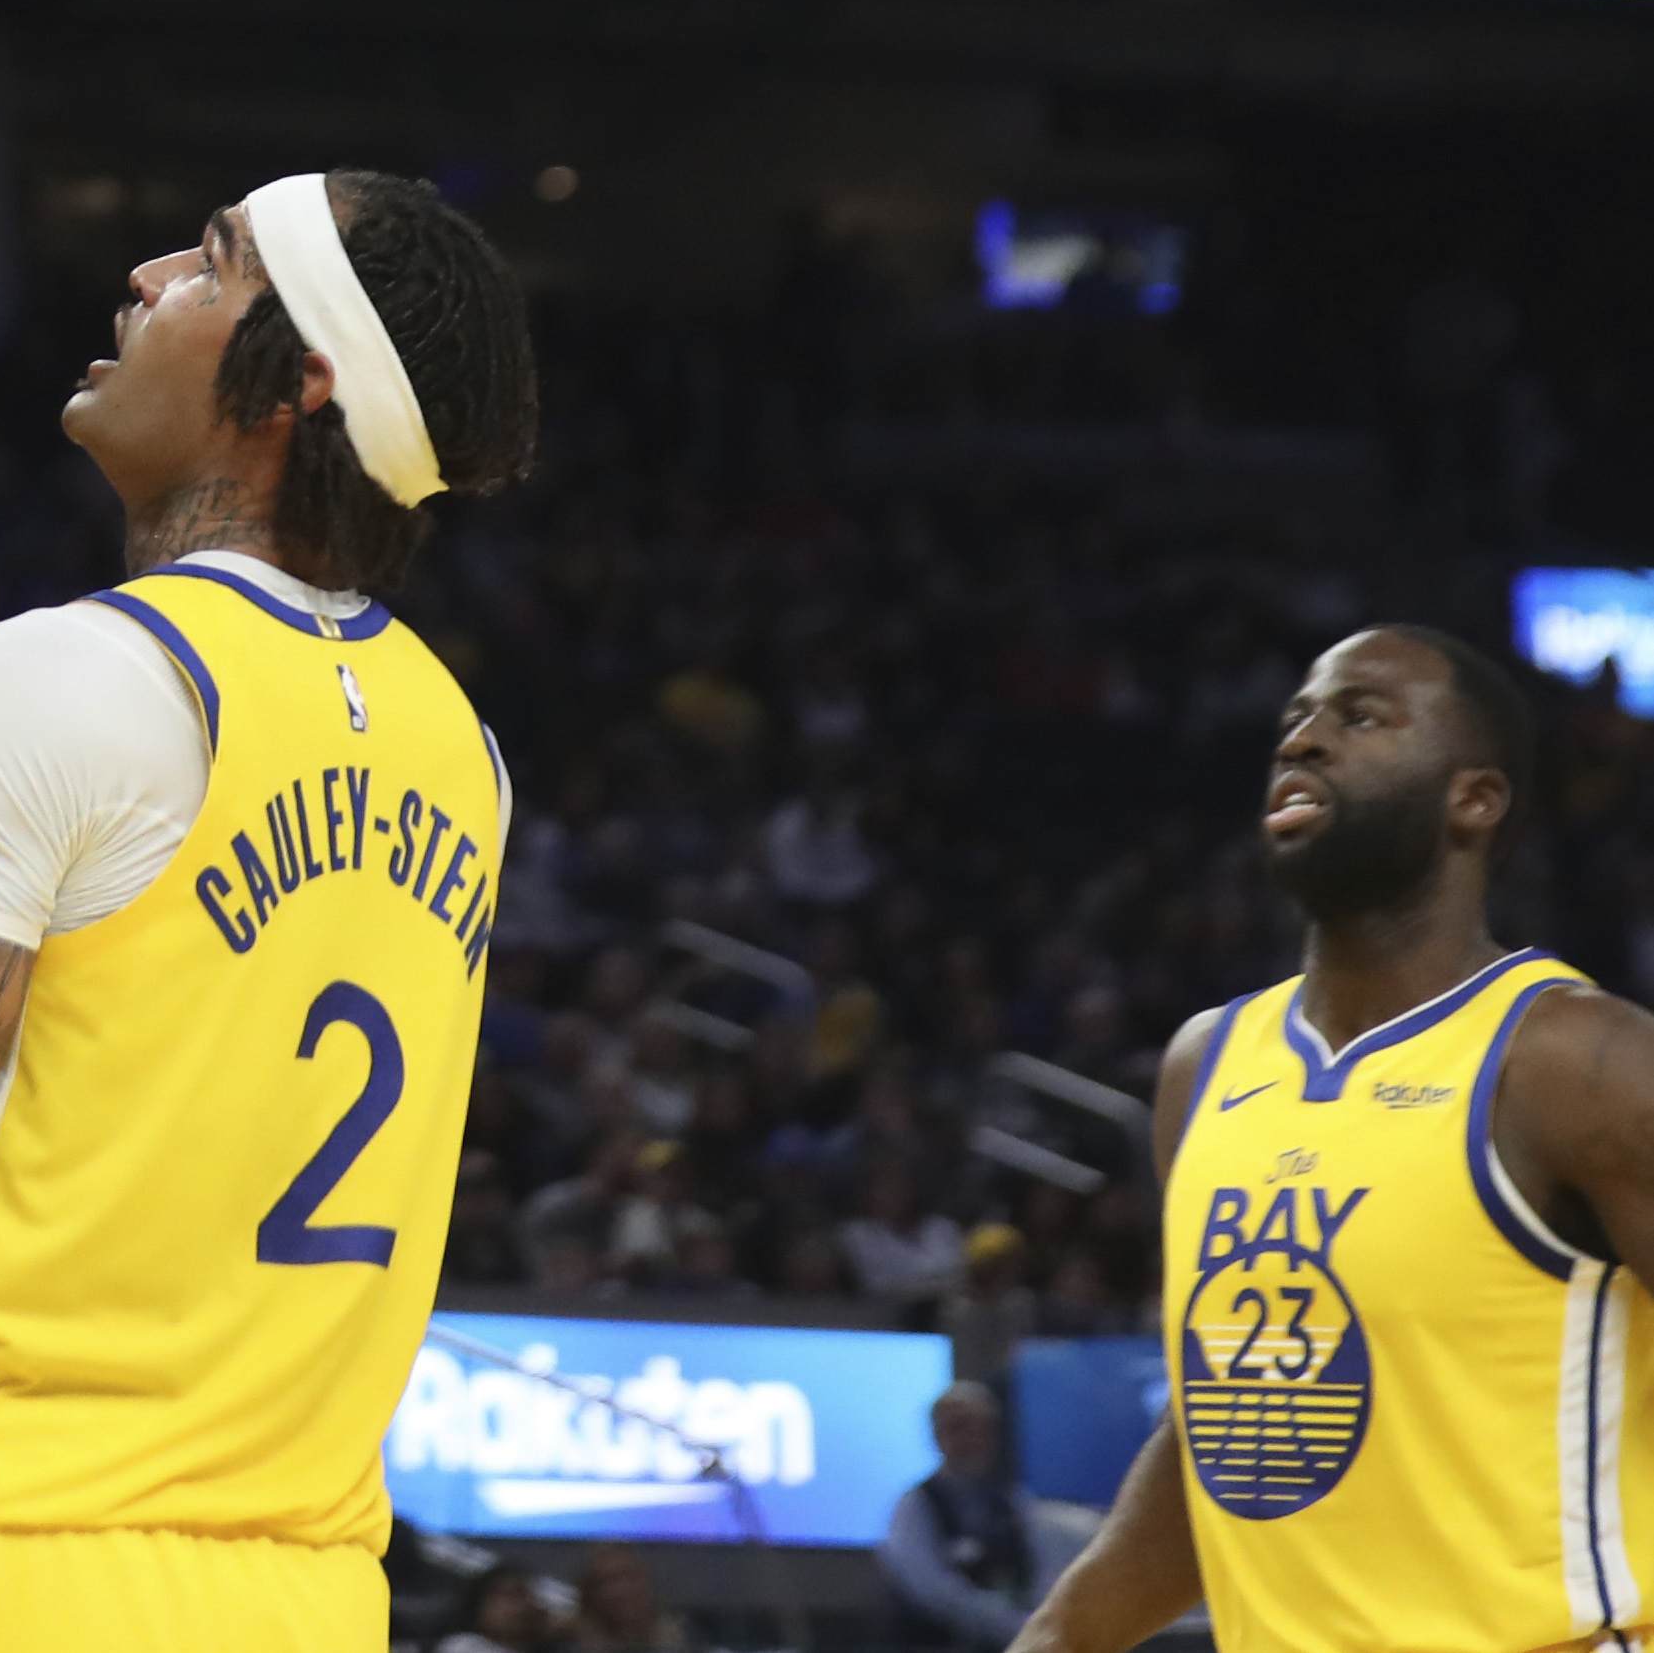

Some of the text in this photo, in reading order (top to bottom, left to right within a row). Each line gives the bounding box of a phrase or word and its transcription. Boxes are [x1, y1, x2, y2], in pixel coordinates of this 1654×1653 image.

[256, 980, 406, 1270] 2
[1264, 1146, 1317, 1185] The
[1195, 1187, 1373, 1273] BAY
[1225, 1287, 1317, 1381] 23
[385, 1344, 817, 1491] Rakuten
